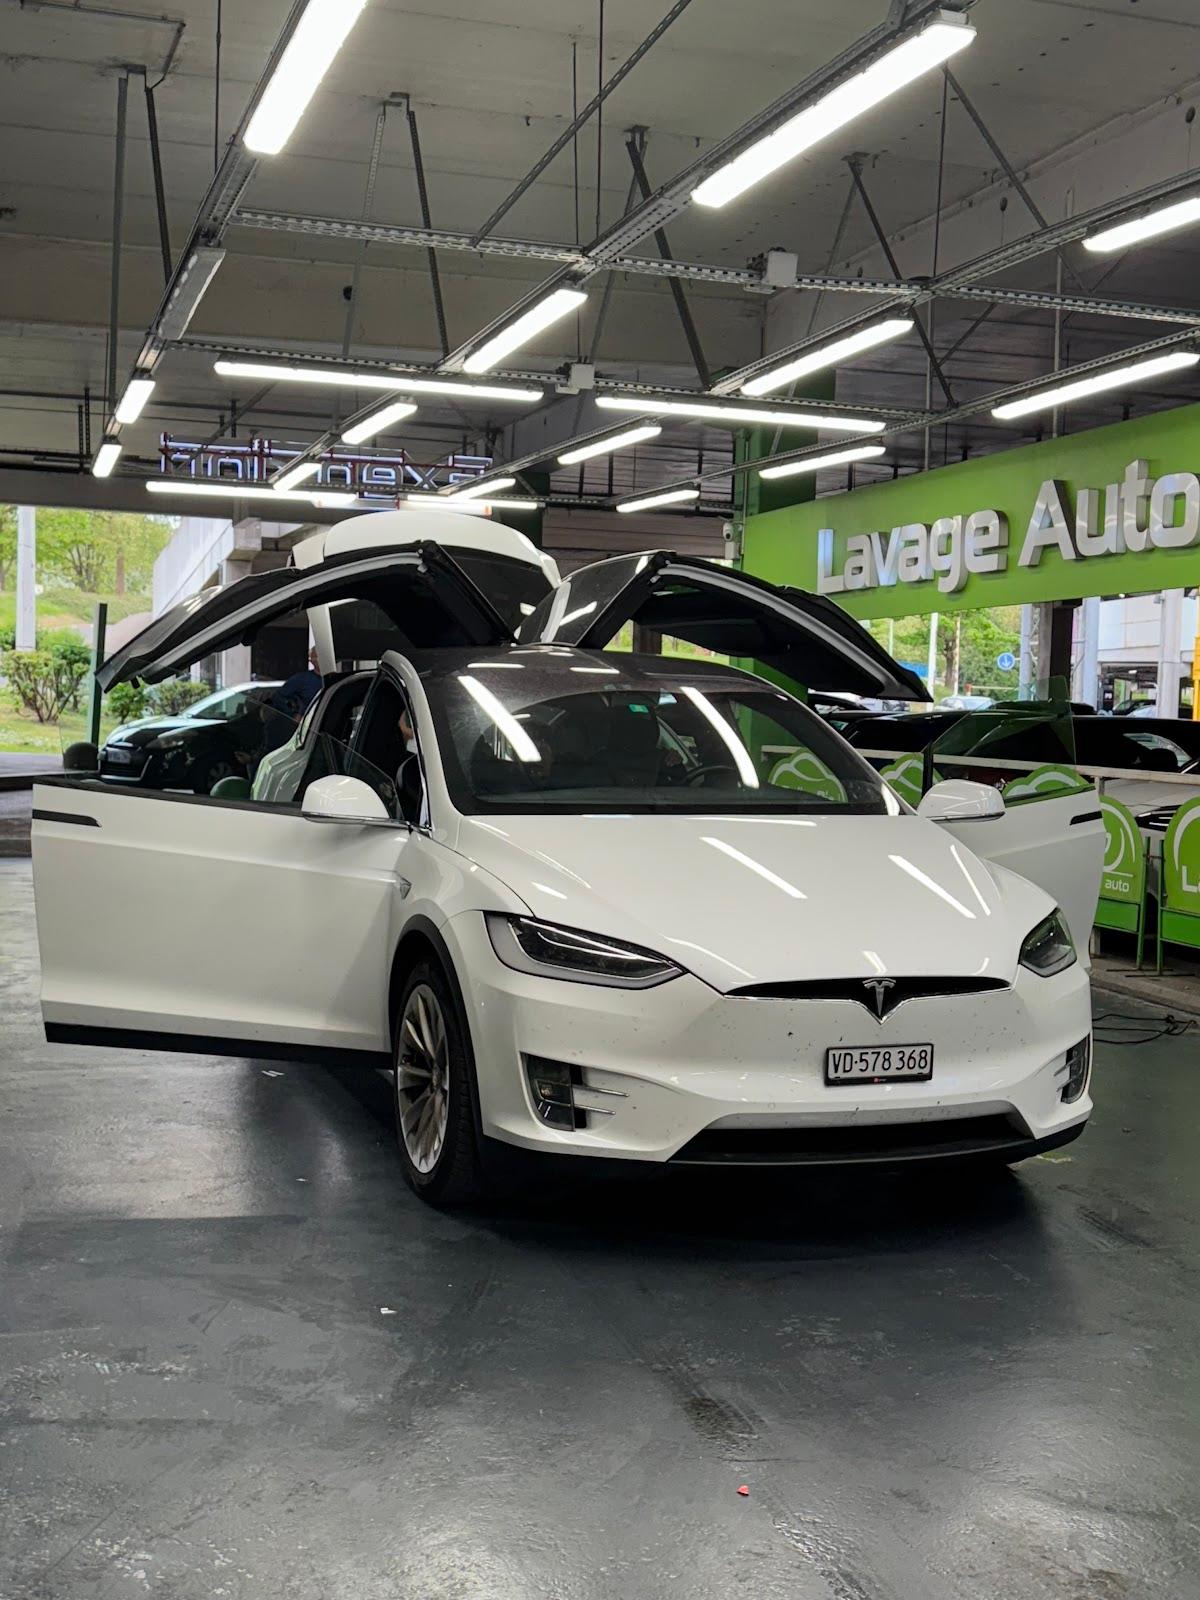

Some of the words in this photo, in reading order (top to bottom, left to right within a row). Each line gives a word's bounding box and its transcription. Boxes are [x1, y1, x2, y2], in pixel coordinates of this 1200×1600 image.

[817, 509, 1009, 594] Lavage
[1018, 459, 1200, 567] Auto
[1105, 879, 1130, 893] auto
